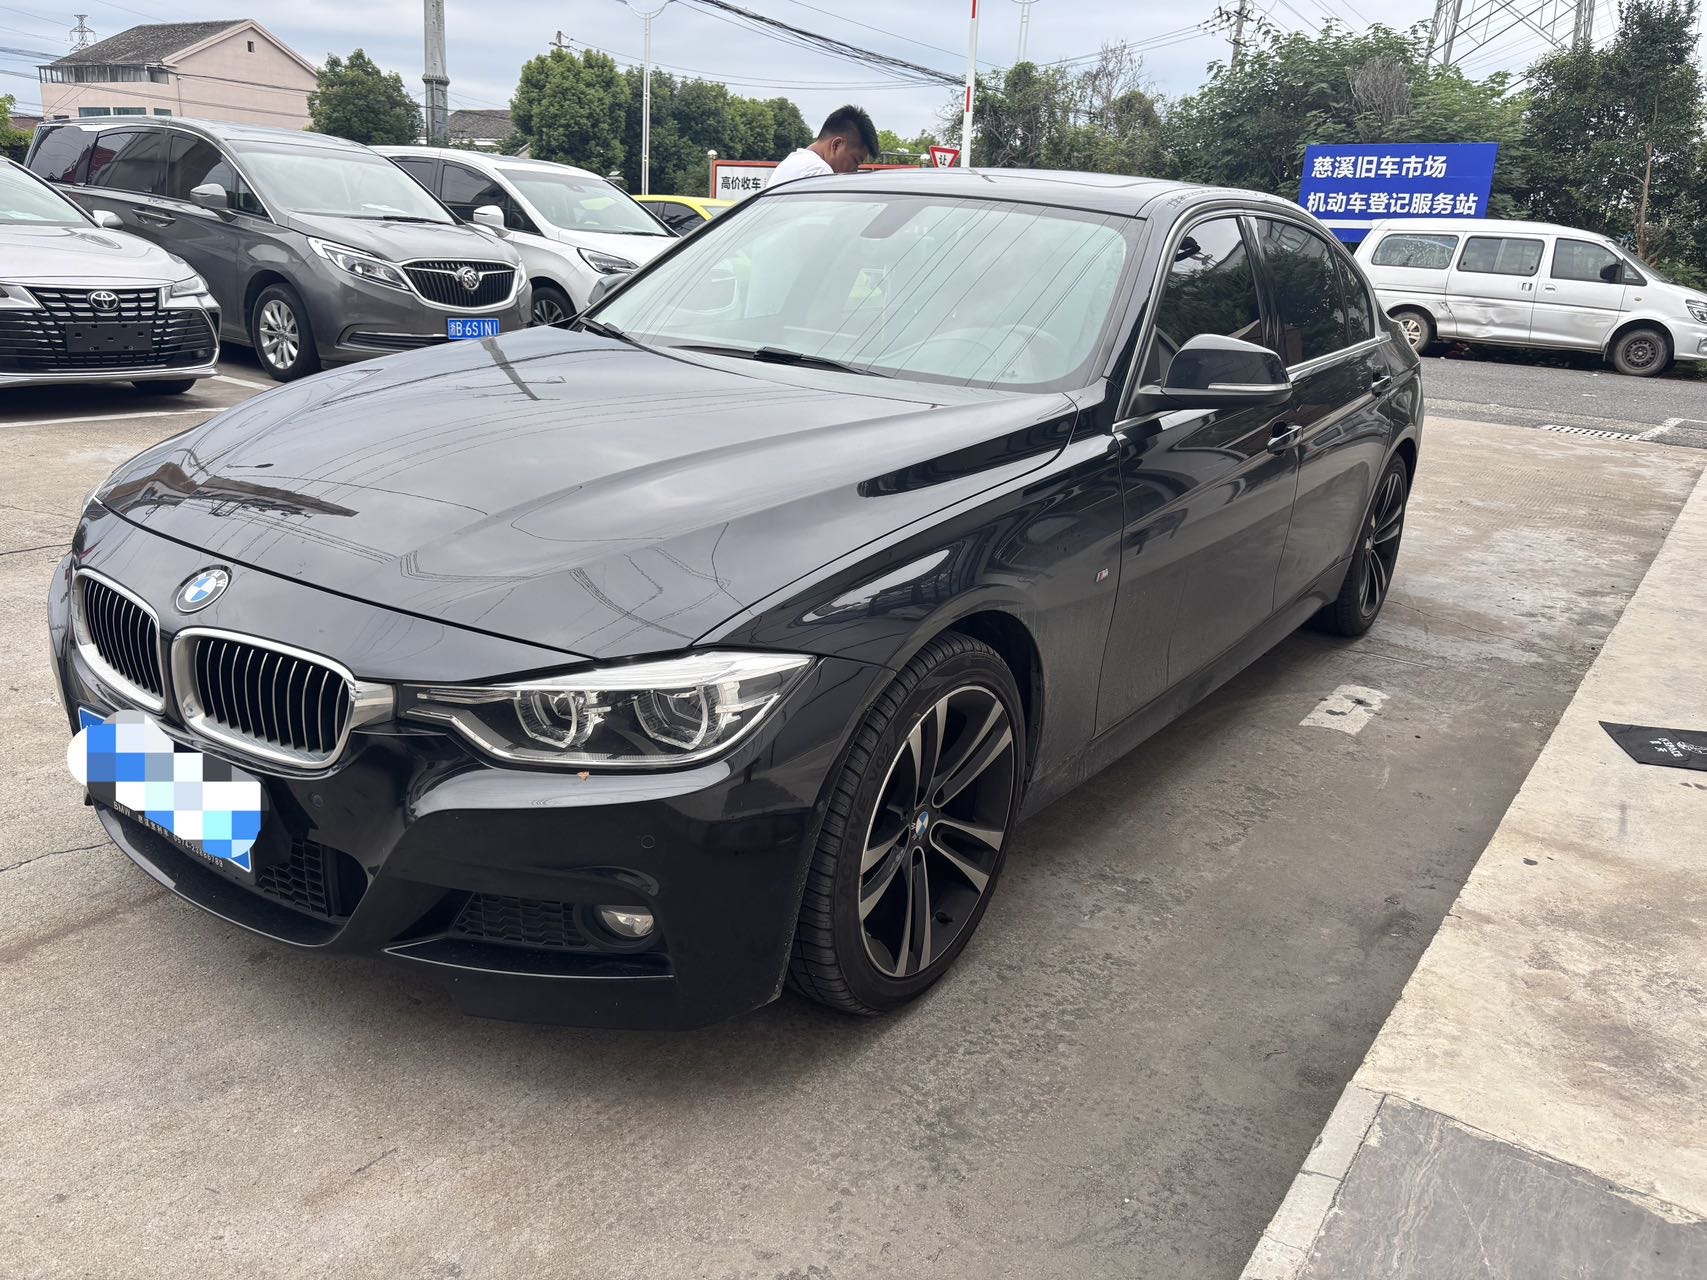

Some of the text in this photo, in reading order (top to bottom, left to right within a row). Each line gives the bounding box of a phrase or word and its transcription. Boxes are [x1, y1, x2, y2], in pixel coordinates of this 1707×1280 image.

[938, 154, 949, 166] 让
[1311, 155, 1447, 178] 慈溪旧车市场
[720, 176, 761, 191] 高价收车
[1306, 192, 1478, 216] 机动车登记服务站
[113, 801, 131, 816] BMW
